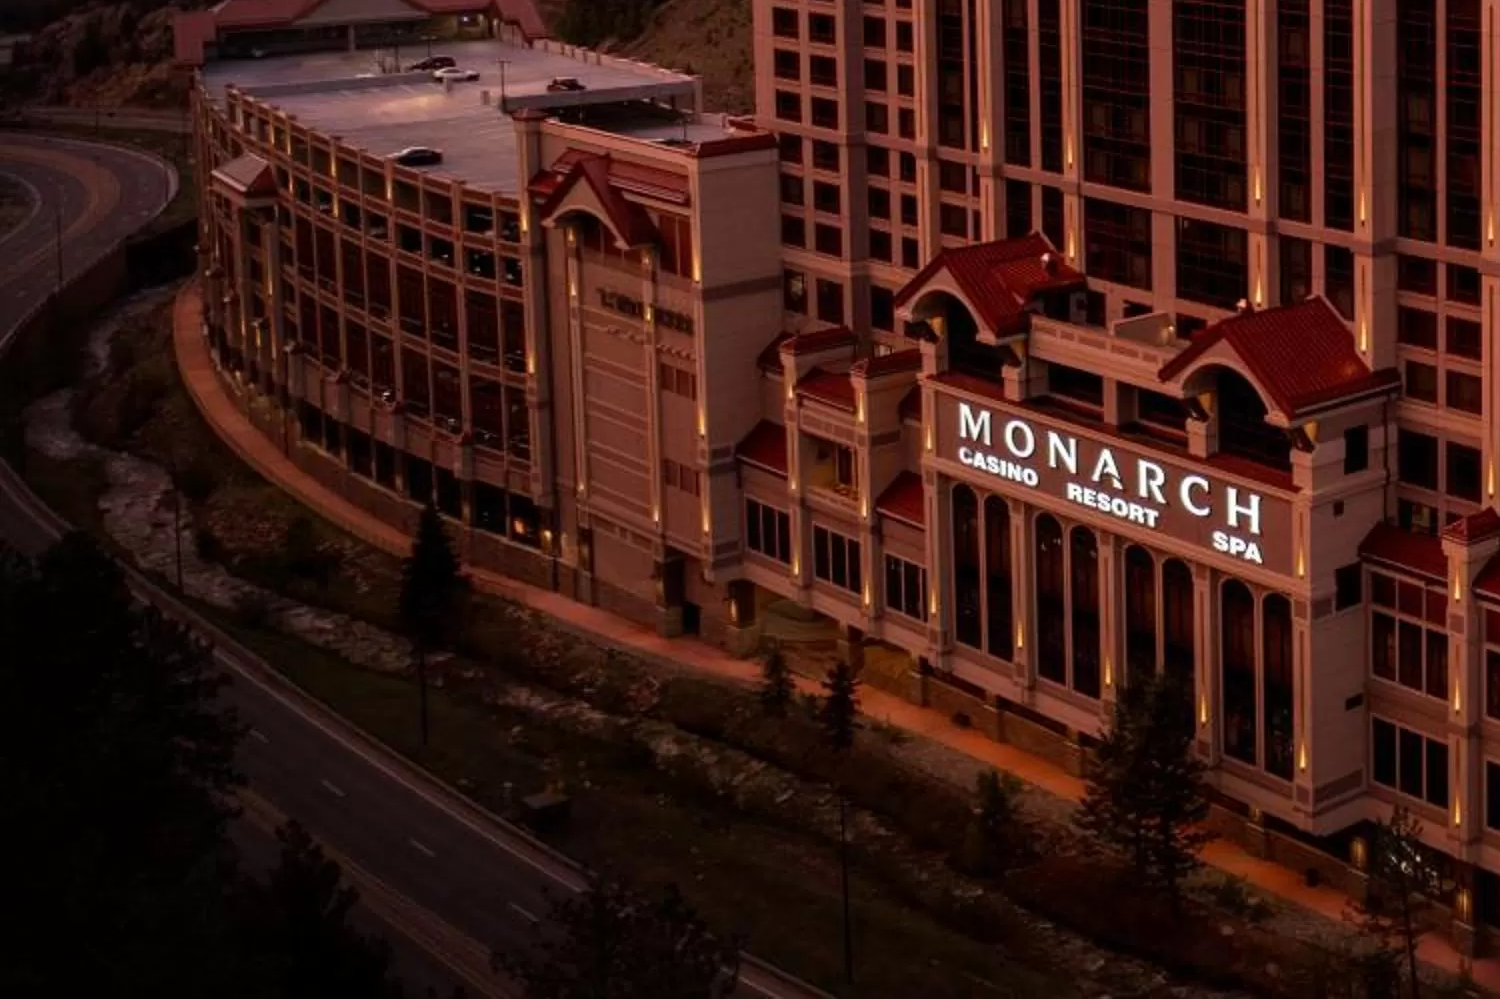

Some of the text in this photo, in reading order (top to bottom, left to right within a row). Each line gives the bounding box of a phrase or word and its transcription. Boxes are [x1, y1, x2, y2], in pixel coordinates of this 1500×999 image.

[958, 402, 1261, 535] MONARCH
[958, 446, 1263, 565] CASINO RESORT SPA
